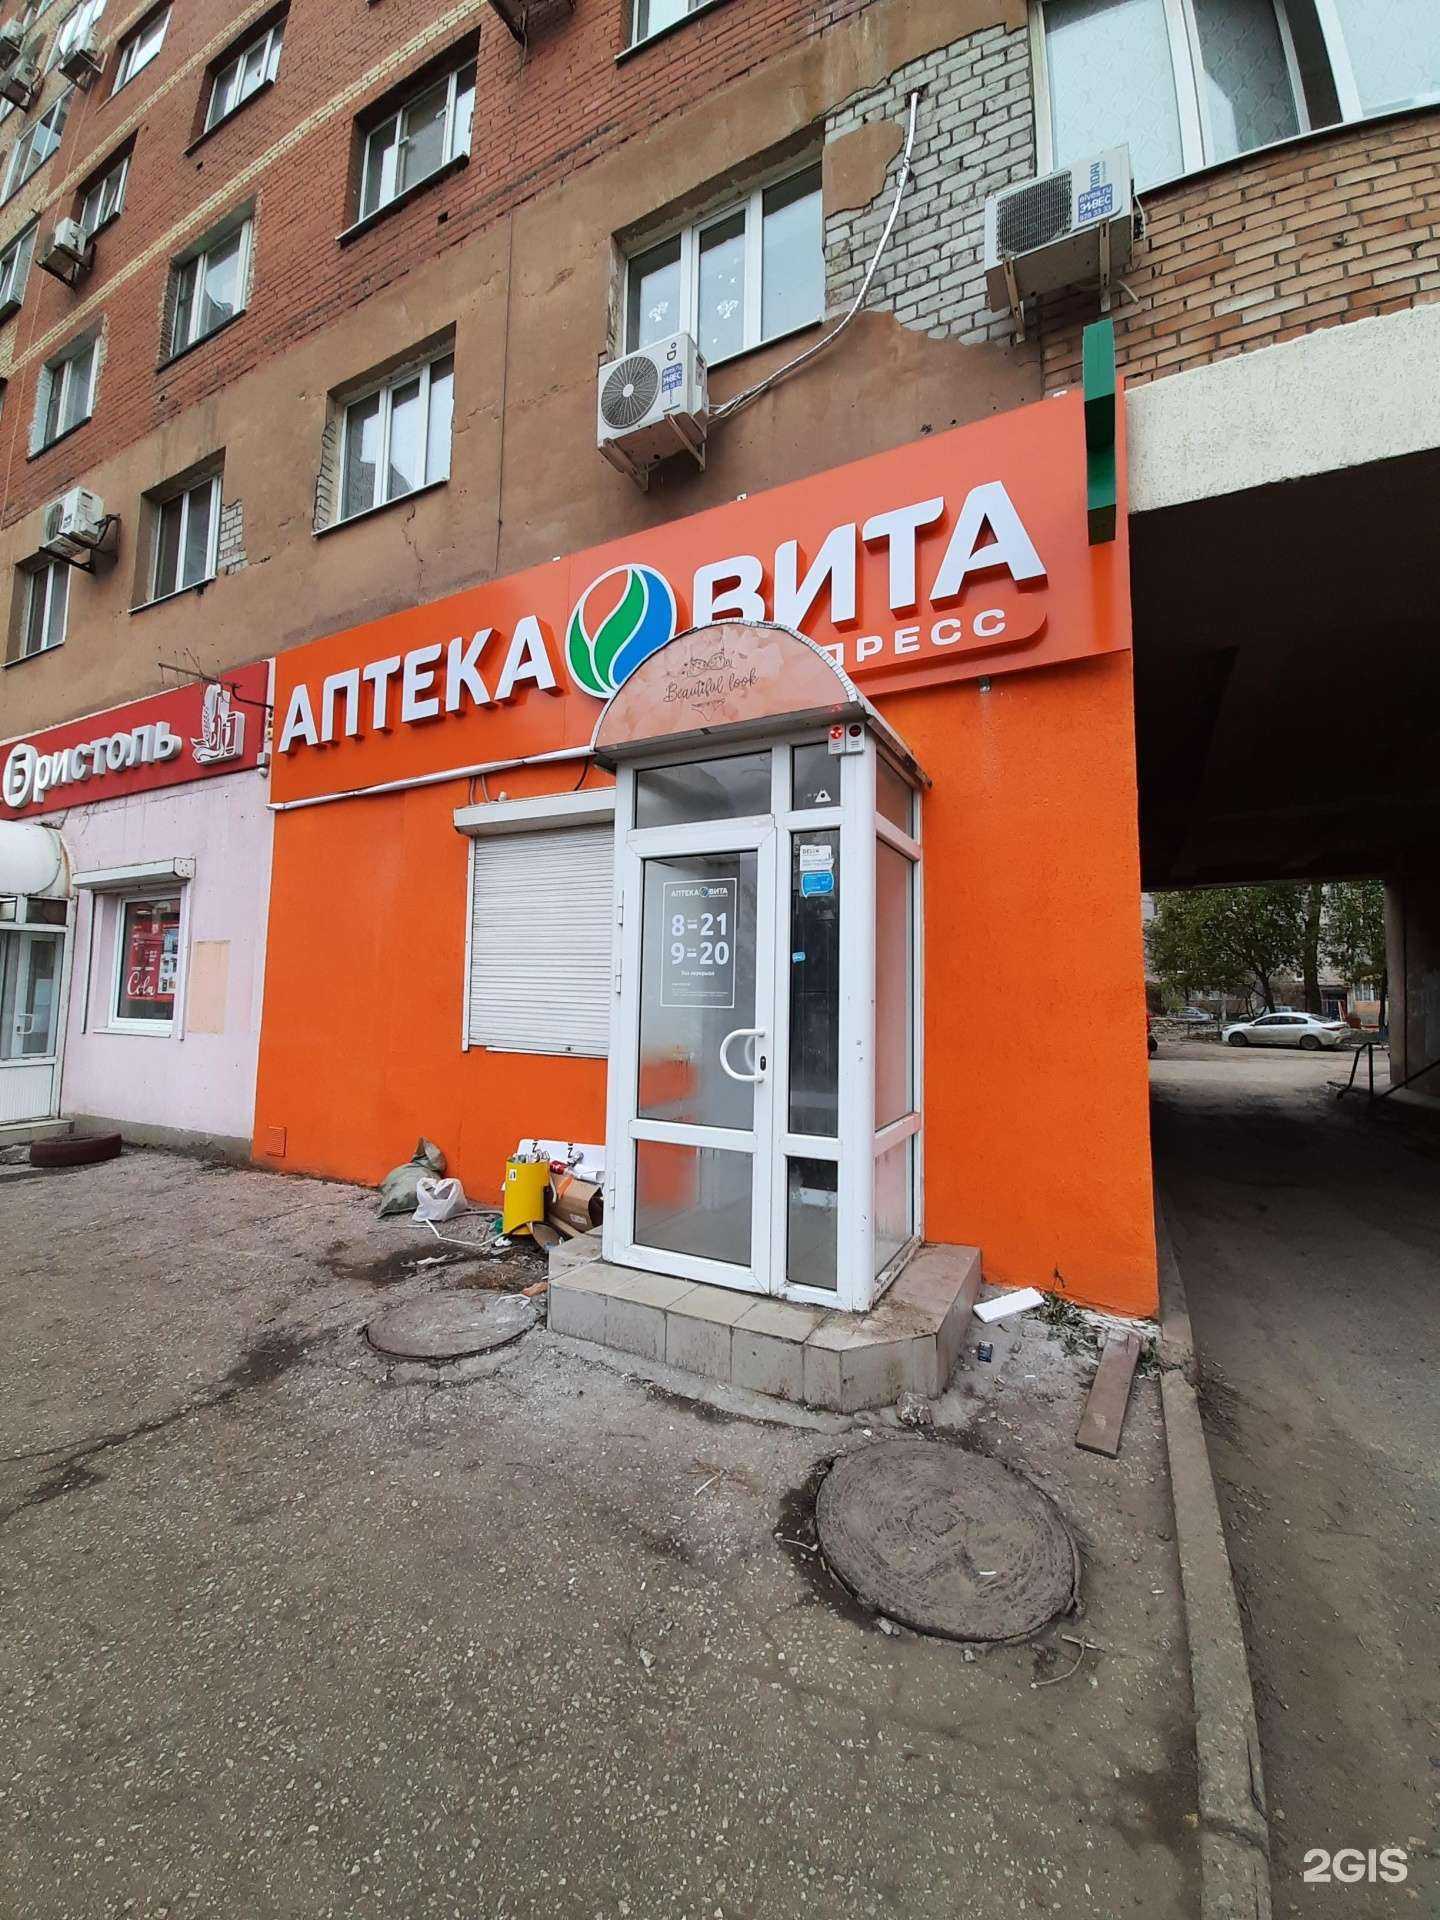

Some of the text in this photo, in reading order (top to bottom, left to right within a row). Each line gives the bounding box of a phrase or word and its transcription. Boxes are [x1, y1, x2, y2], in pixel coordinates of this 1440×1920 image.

[278, 480, 1047, 753] АПТЕКА ВИТА
[663, 667, 759, 702] Beautiful look
[671, 888, 699, 897] АПТЕКА
[708, 887, 728, 895] ВИТА
[127, 971, 155, 996] Cola
